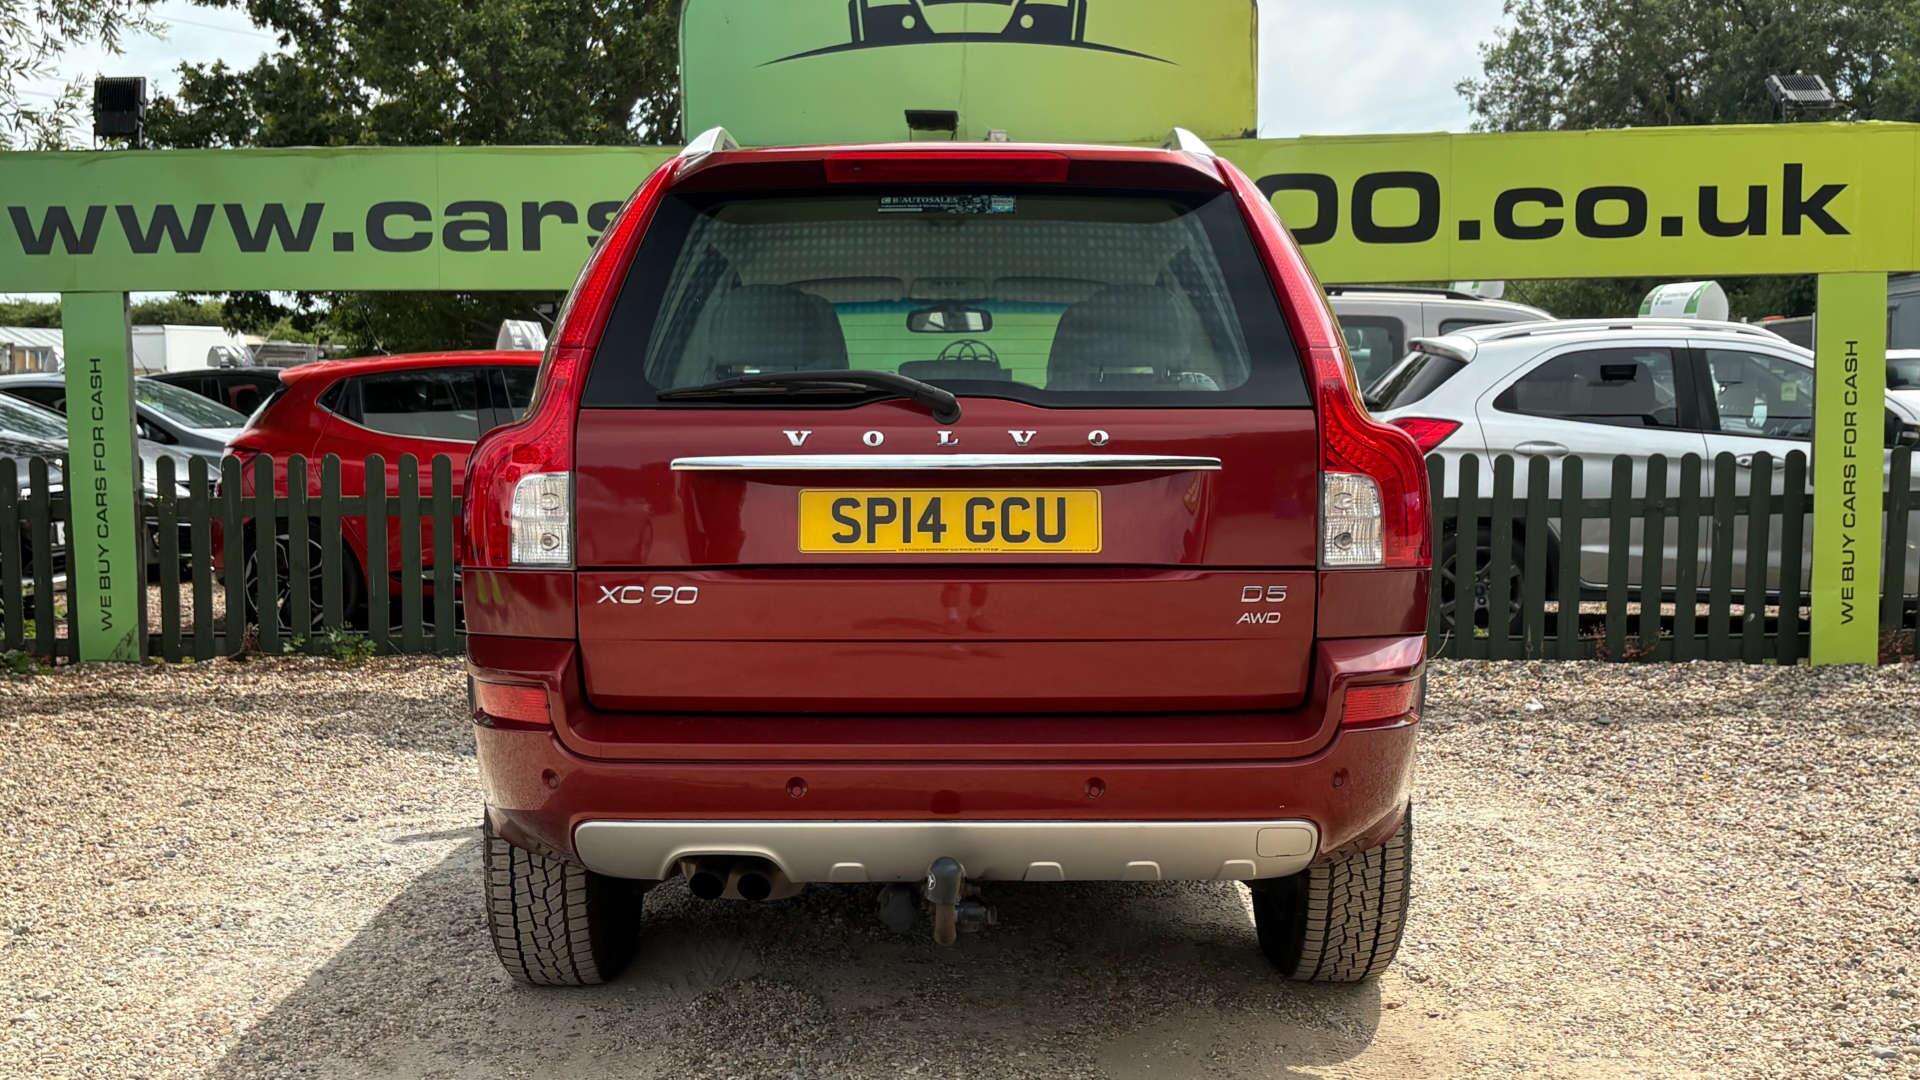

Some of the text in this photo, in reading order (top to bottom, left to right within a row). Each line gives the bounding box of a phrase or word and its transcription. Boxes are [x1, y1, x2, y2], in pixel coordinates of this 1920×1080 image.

[783, 430, 1110, 447] VOLVO
[90, 358, 113, 632] WE BUY CARS FOR CASH
[1840, 340, 1859, 625] WE BUY CARS FOR CASH
[831, 496, 1067, 544] SP14 GCU
[1240, 585, 1288, 602] D5
[1236, 612, 1281, 624] AWD
